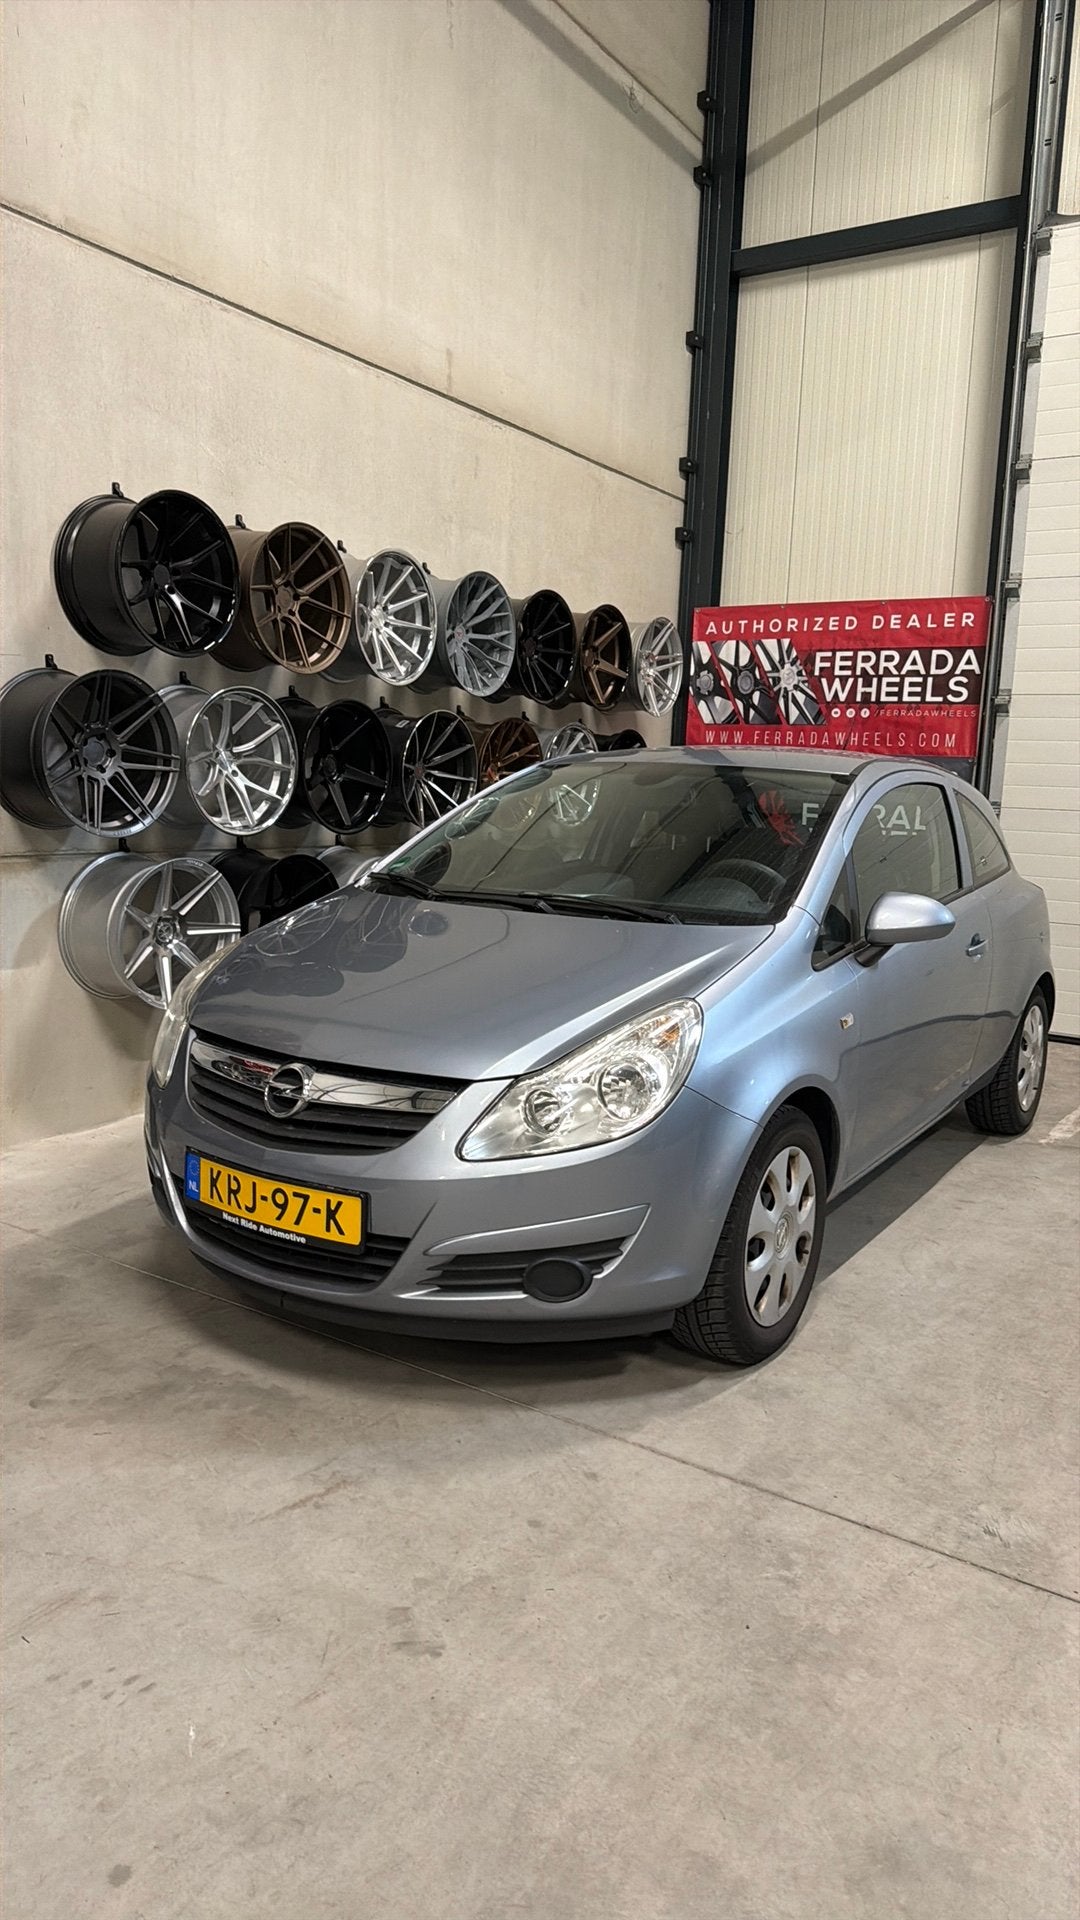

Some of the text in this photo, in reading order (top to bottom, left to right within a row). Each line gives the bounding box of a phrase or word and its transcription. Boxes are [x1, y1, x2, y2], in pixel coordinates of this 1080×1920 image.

[705, 612, 975, 635] AUTHORIZED DEALER
[813, 649, 981, 676] FERRADA
[821, 676, 969, 703] WHEELS
[705, 730, 956, 748] WWW.FERRADAWHEELS.COM
[188, 1181, 199, 1193] NL
[209, 1167, 346, 1236] KRJ-97-K
[222, 1211, 307, 1244] Next Ride Automotive
